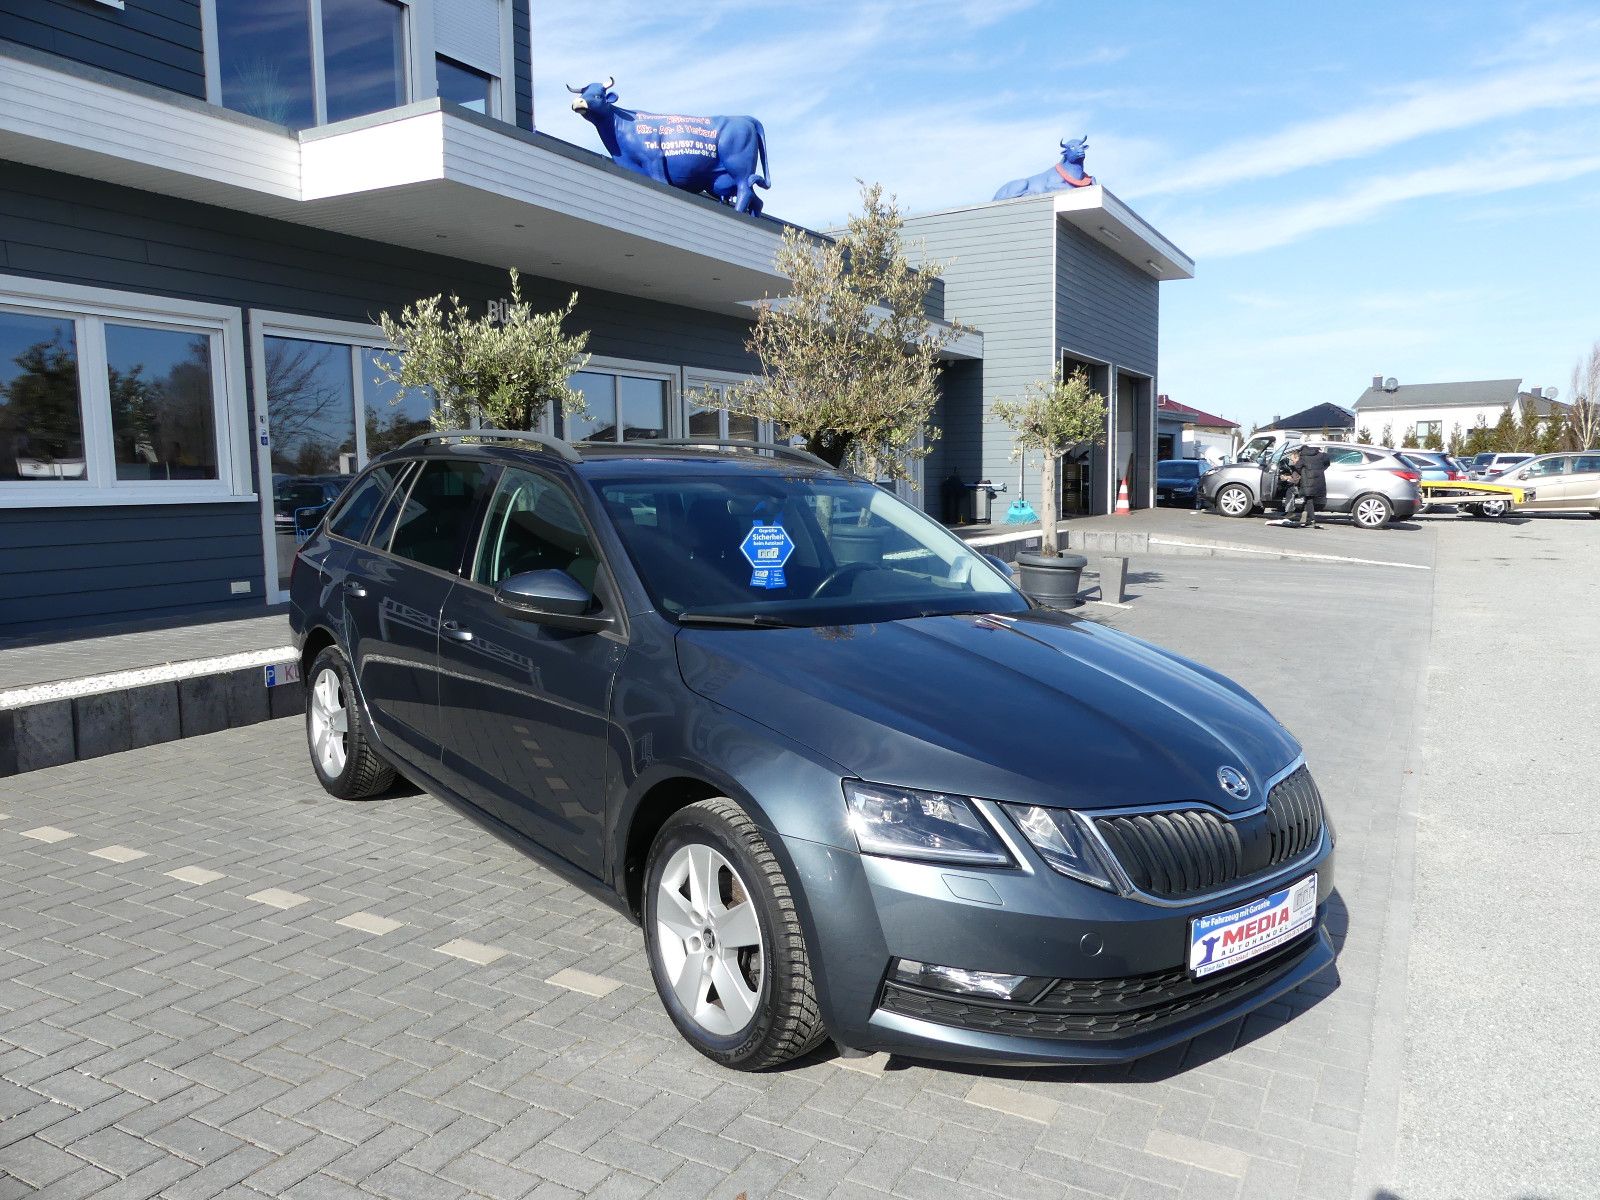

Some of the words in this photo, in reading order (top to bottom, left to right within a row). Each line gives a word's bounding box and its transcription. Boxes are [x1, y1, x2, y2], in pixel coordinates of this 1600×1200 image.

[645, 141, 659, 149] Tel.
[1211, 911, 1239, 926] Fahrzeug
[1239, 907, 1250, 918] mit
[1249, 900, 1271, 914] Garantie
[1222, 907, 1290, 947] MEDIA
[1221, 925, 1289, 956] AUTOHANDEL
